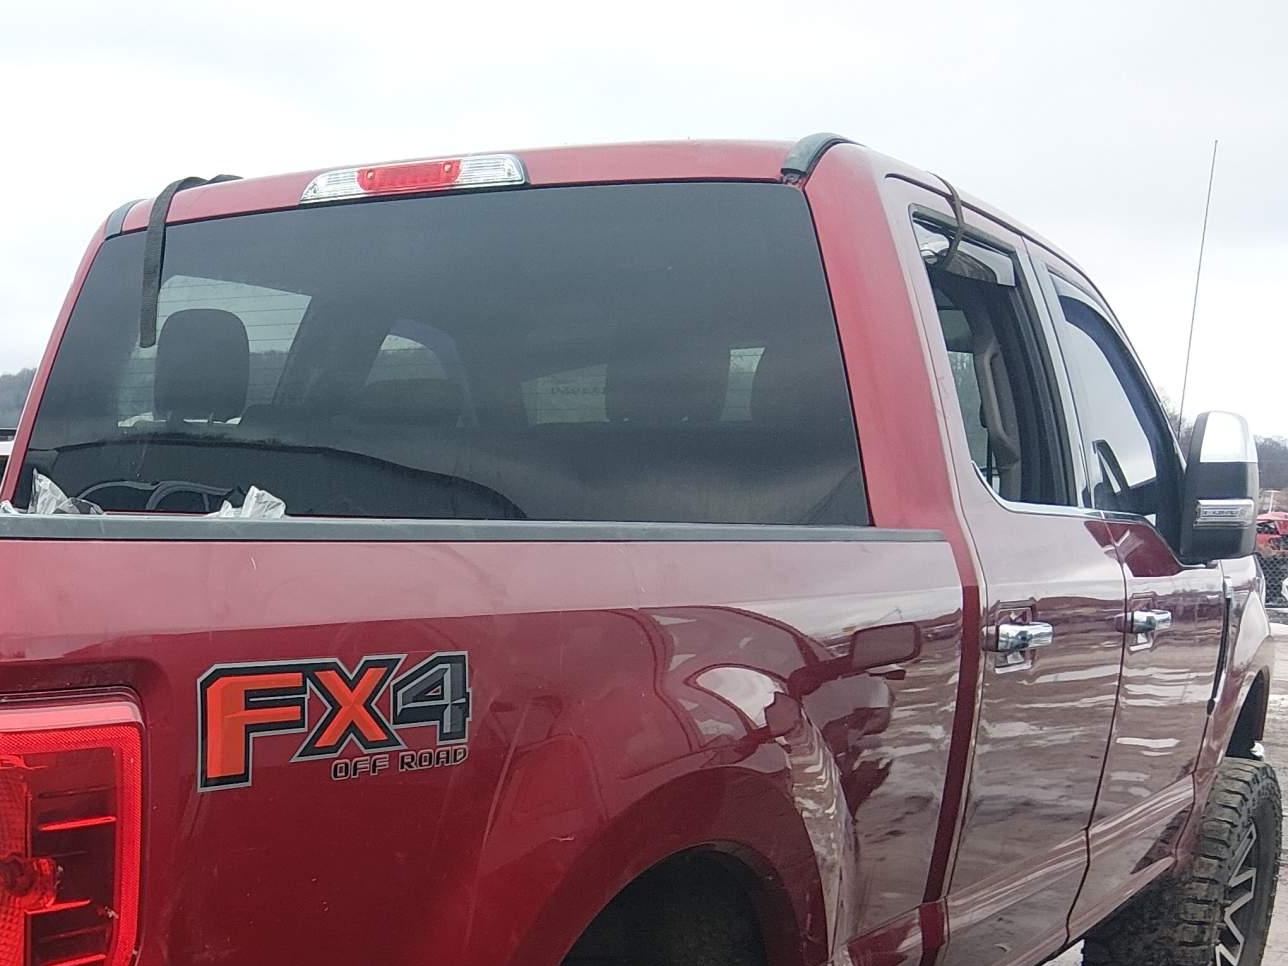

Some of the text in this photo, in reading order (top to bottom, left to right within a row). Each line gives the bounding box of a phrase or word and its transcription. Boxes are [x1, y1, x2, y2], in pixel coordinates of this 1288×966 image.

[197, 651, 472, 792] FX4
[330, 745, 470, 782] OFF ROAD
